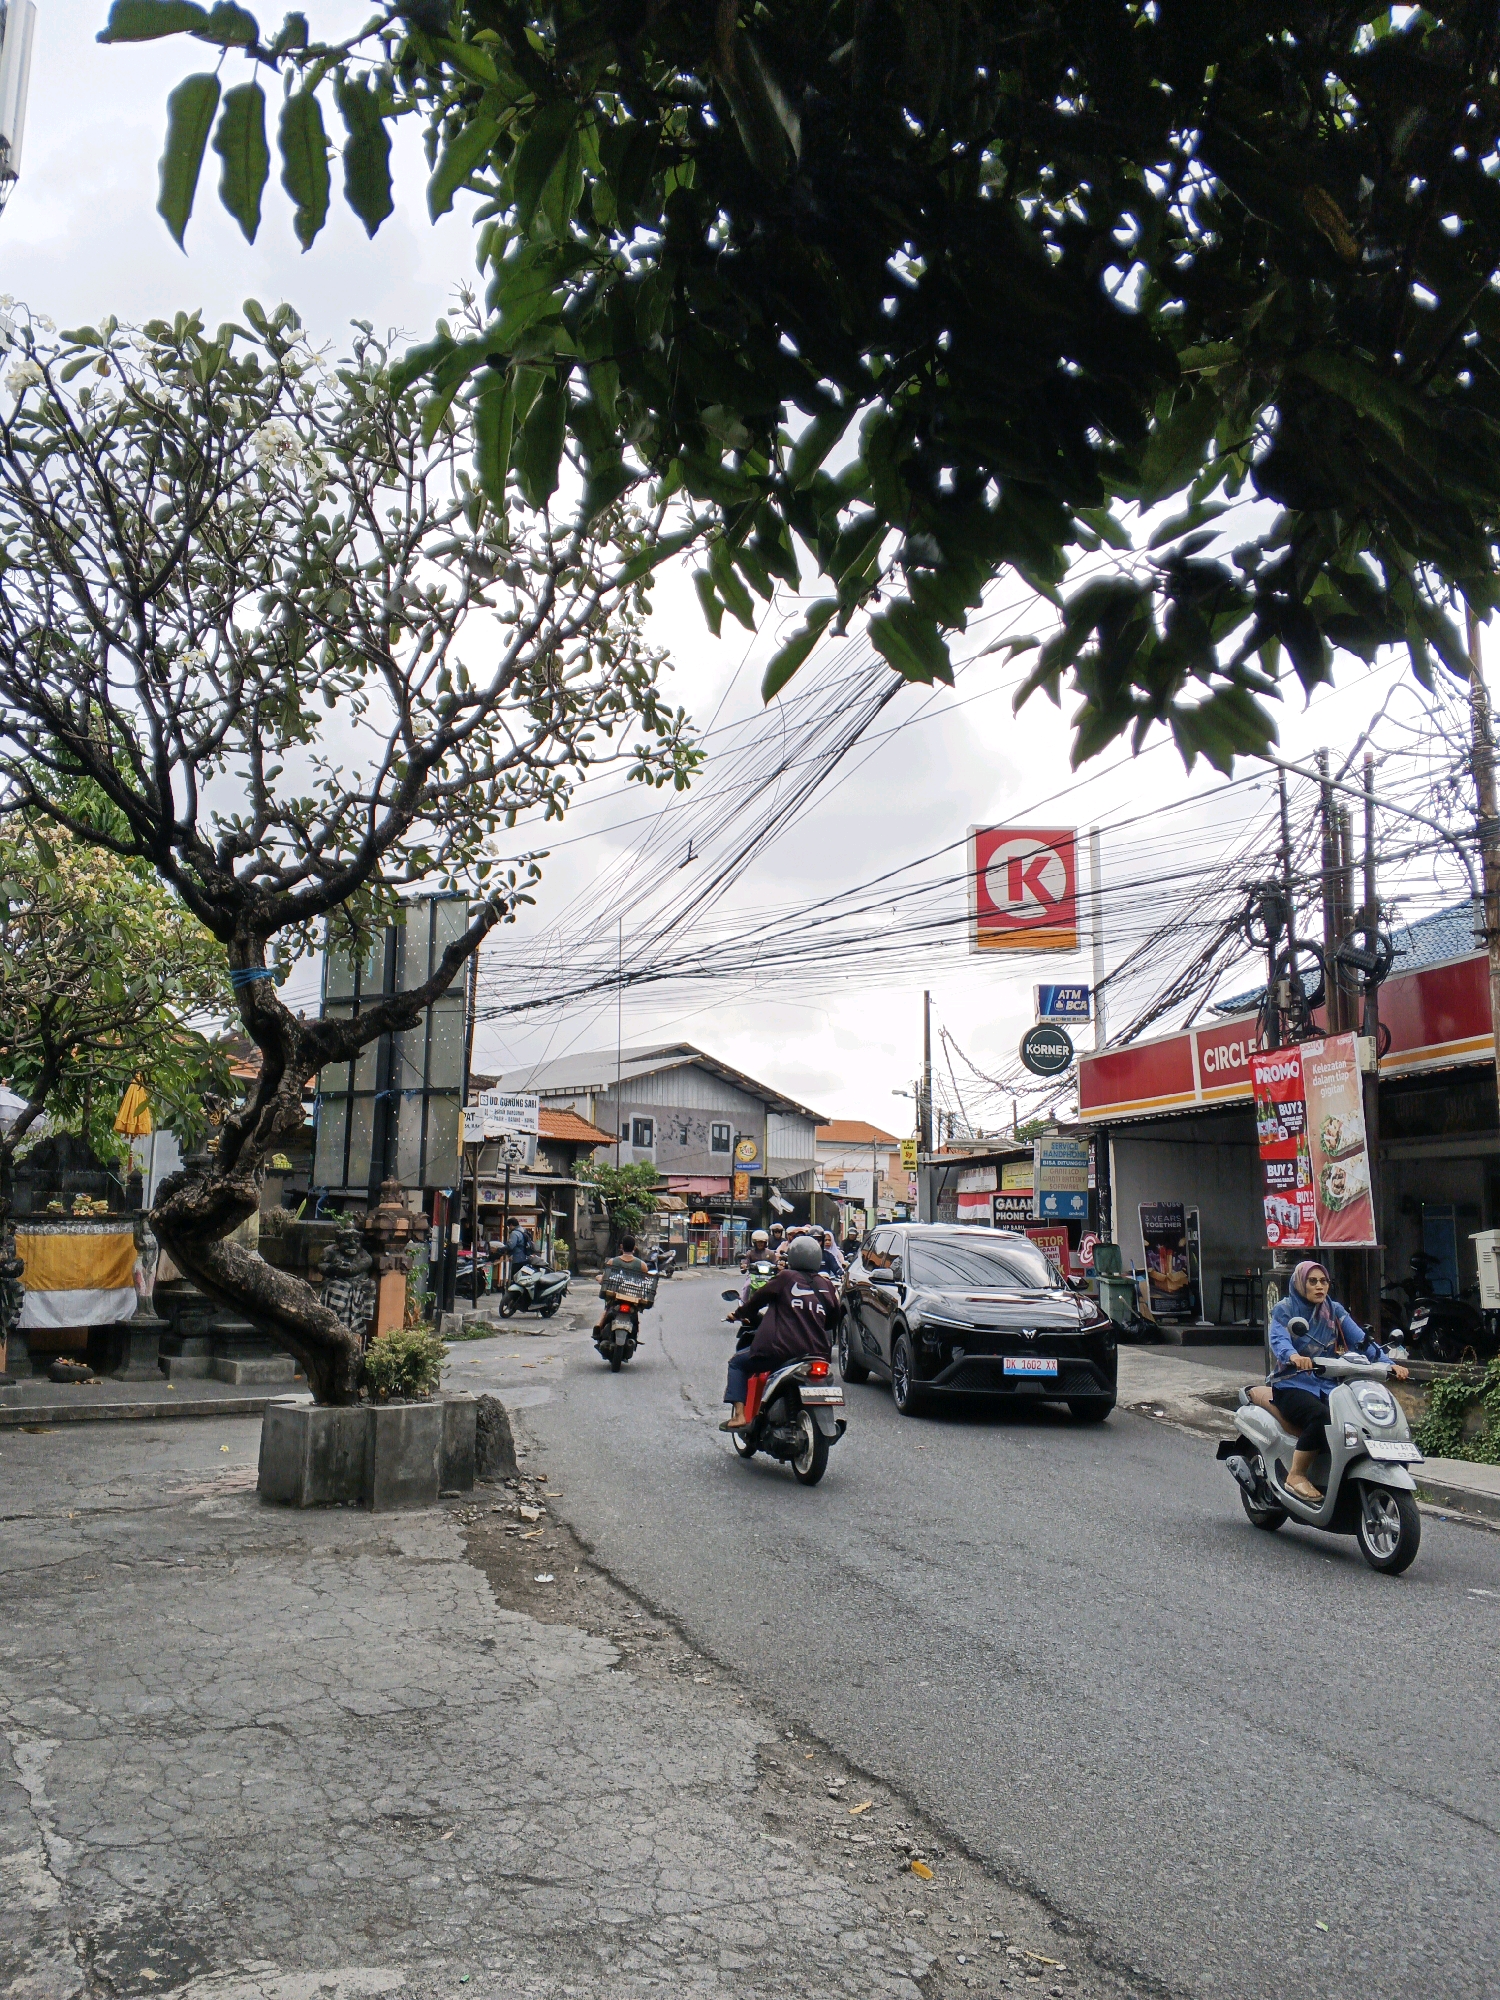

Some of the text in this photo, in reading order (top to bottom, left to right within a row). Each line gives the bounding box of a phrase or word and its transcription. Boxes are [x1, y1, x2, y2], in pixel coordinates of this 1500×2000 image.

[1007, 855, 1054, 906] K
[1058, 990, 1081, 1000] ATM
[1066, 1001, 1088, 1010] BCA
[1026, 1043, 1070, 1056] KÖRNER
[1255, 1061, 1299, 1084] PROMO
[1313, 1060, 1347, 1074] Kelezatan
[1313, 1070, 1349, 1086] dalam tiap
[1321, 1084, 1344, 1098] gigitan
[1279, 1101, 1303, 1116] BUY 2
[1051, 1142, 1079, 1150] SERVICE
[1267, 1164, 1293, 1177] BUY 2
[1296, 1192, 1309, 1203] BUY
[996, 1212, 1024, 1220] PHONE
[791, 1299, 826, 1316] AIR
[1006, 1359, 1056, 1370] DK 1602 XX
